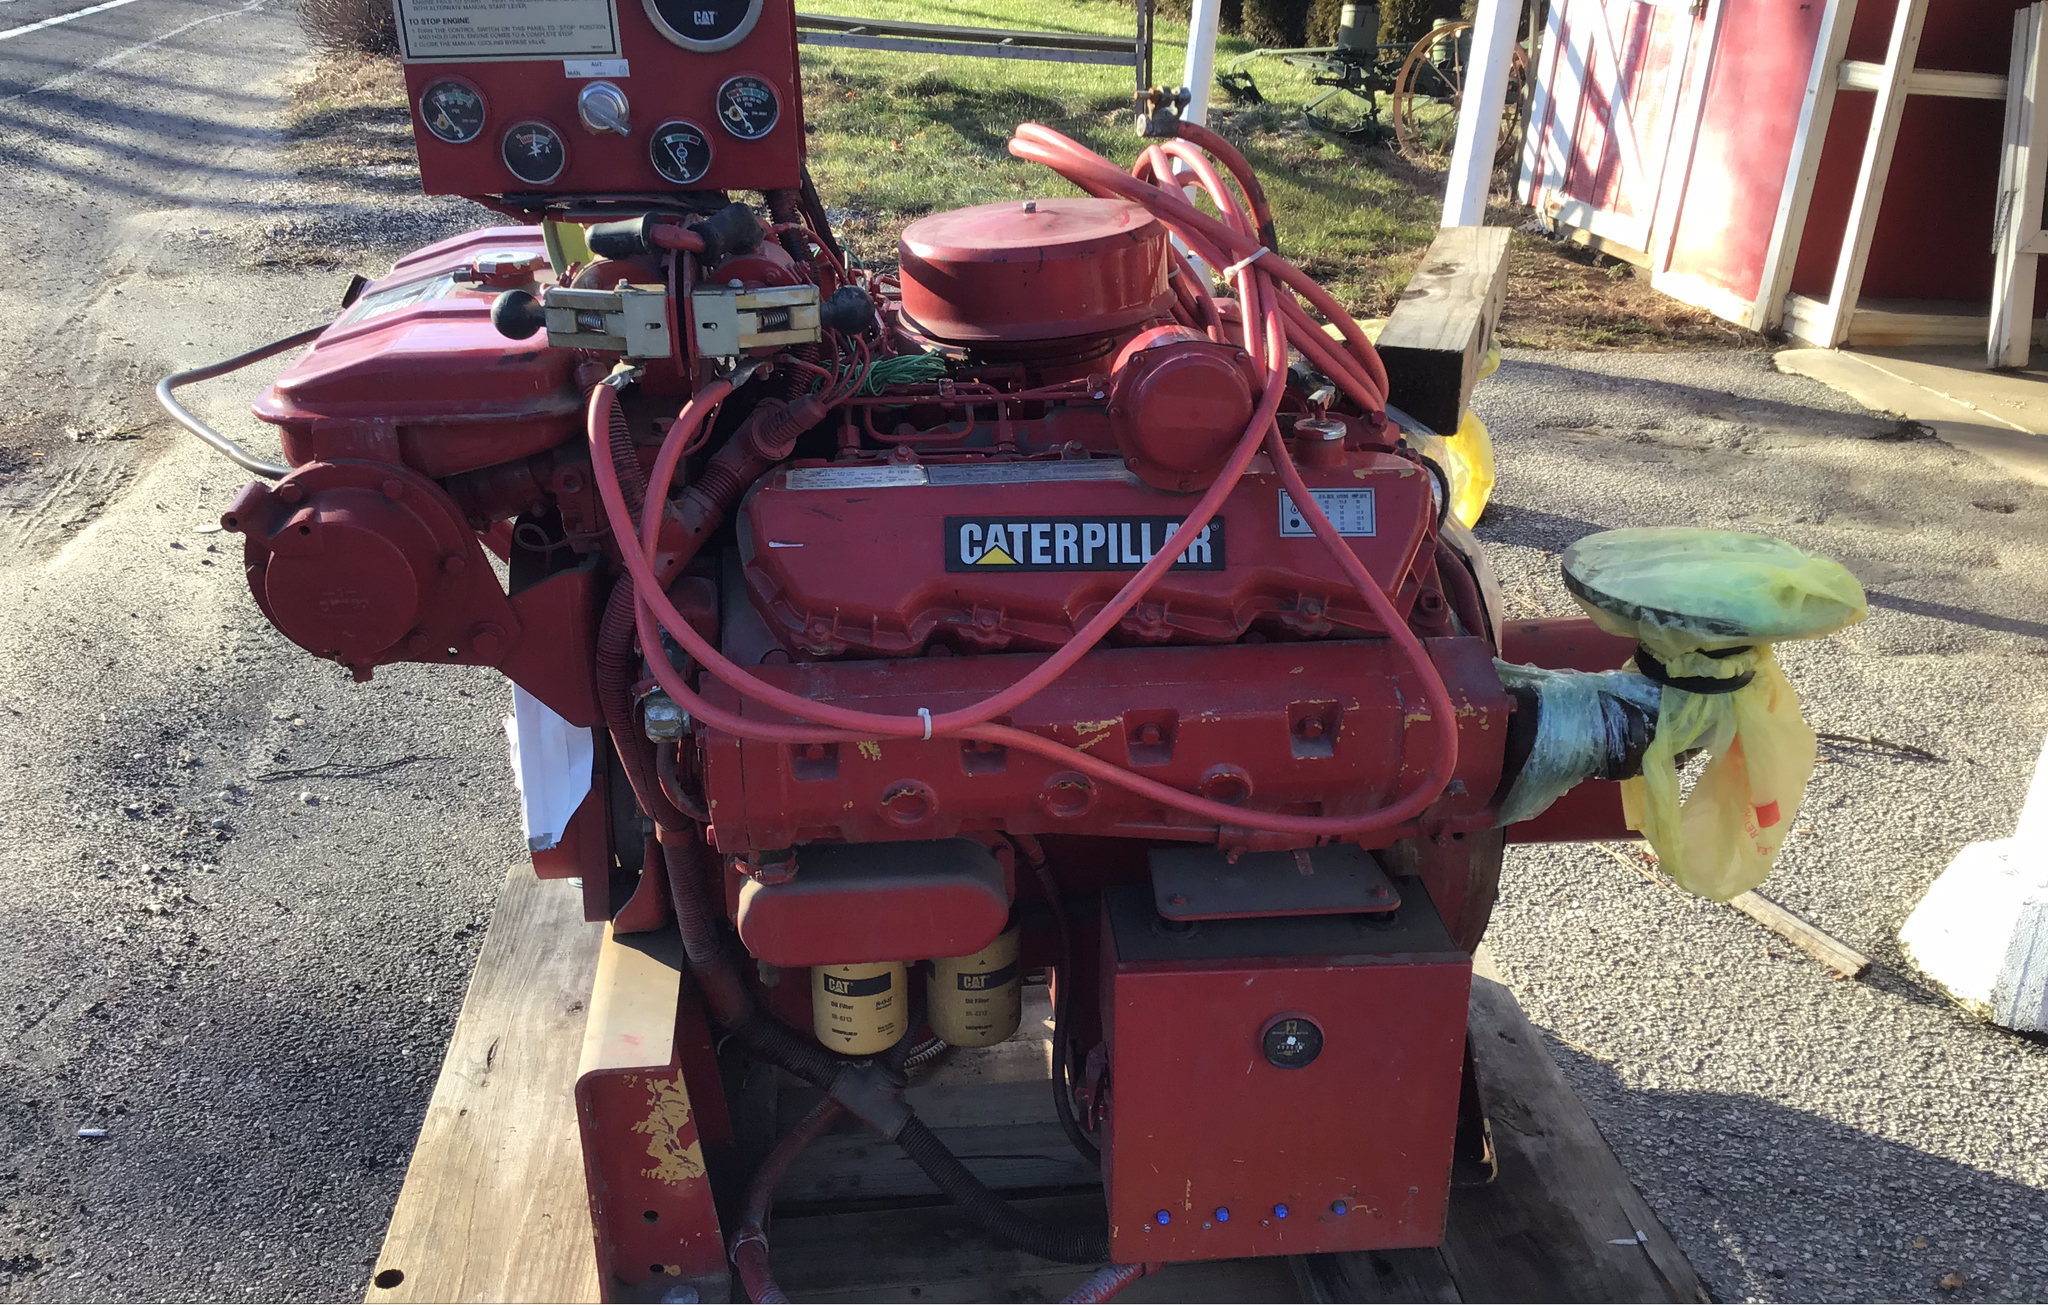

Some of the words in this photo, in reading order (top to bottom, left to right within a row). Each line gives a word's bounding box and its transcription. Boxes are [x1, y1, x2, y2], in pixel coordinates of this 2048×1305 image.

[693, 10, 716, 26] CAT
[829, 979, 850, 994] CAT
[963, 975, 987, 989] CAT
